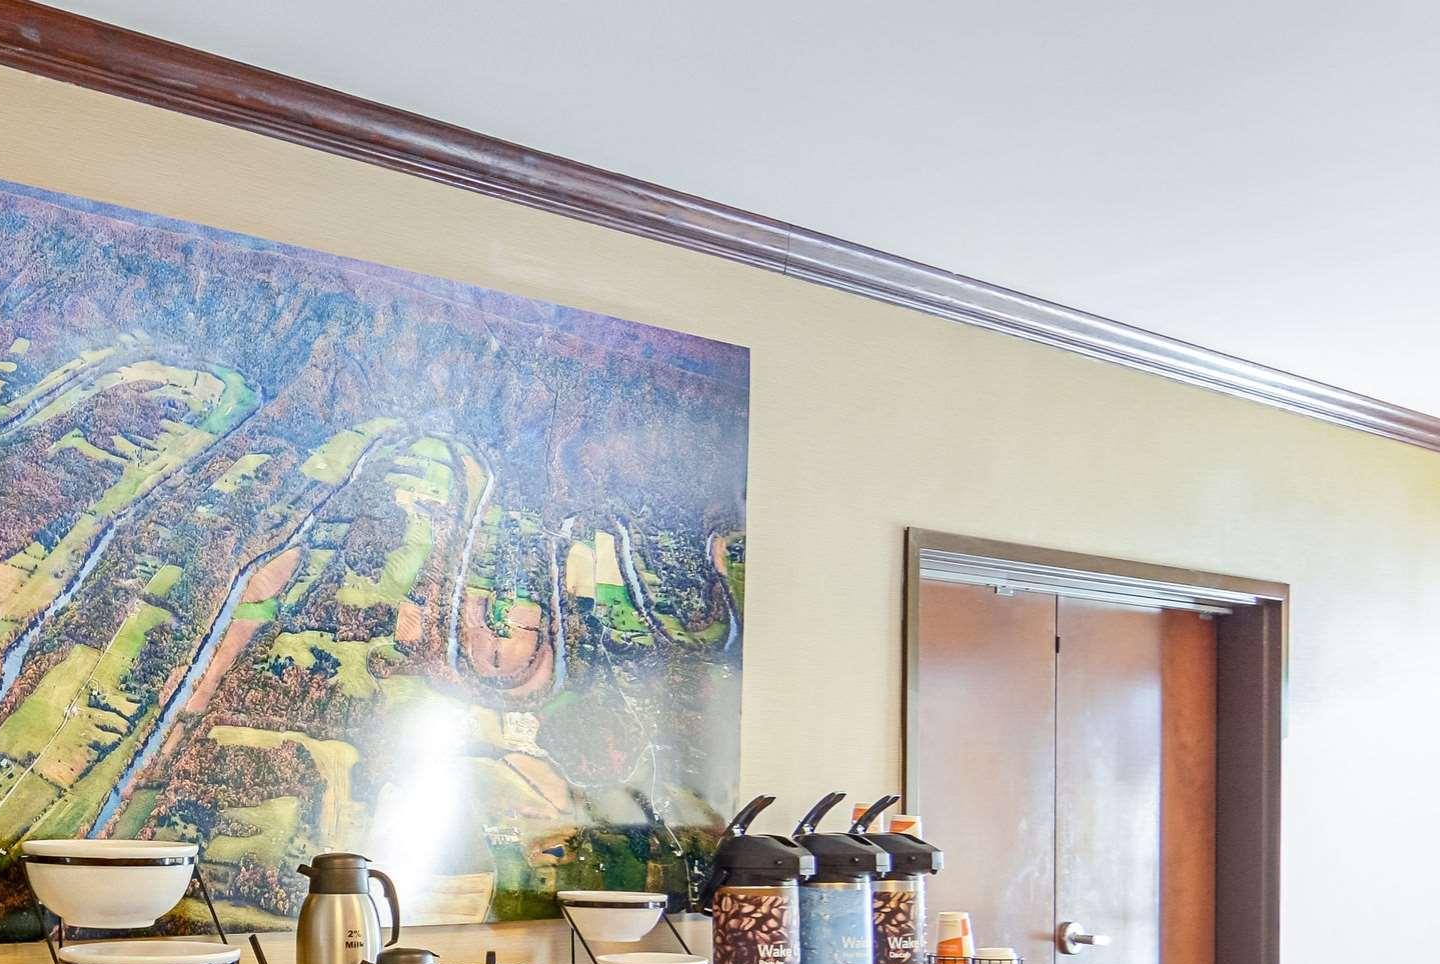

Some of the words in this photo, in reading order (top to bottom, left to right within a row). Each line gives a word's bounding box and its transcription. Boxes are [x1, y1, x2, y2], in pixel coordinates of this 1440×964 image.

[347, 930, 362, 938] 2%
[345, 941, 364, 949] Milk
[757, 944, 793, 958] Wake
